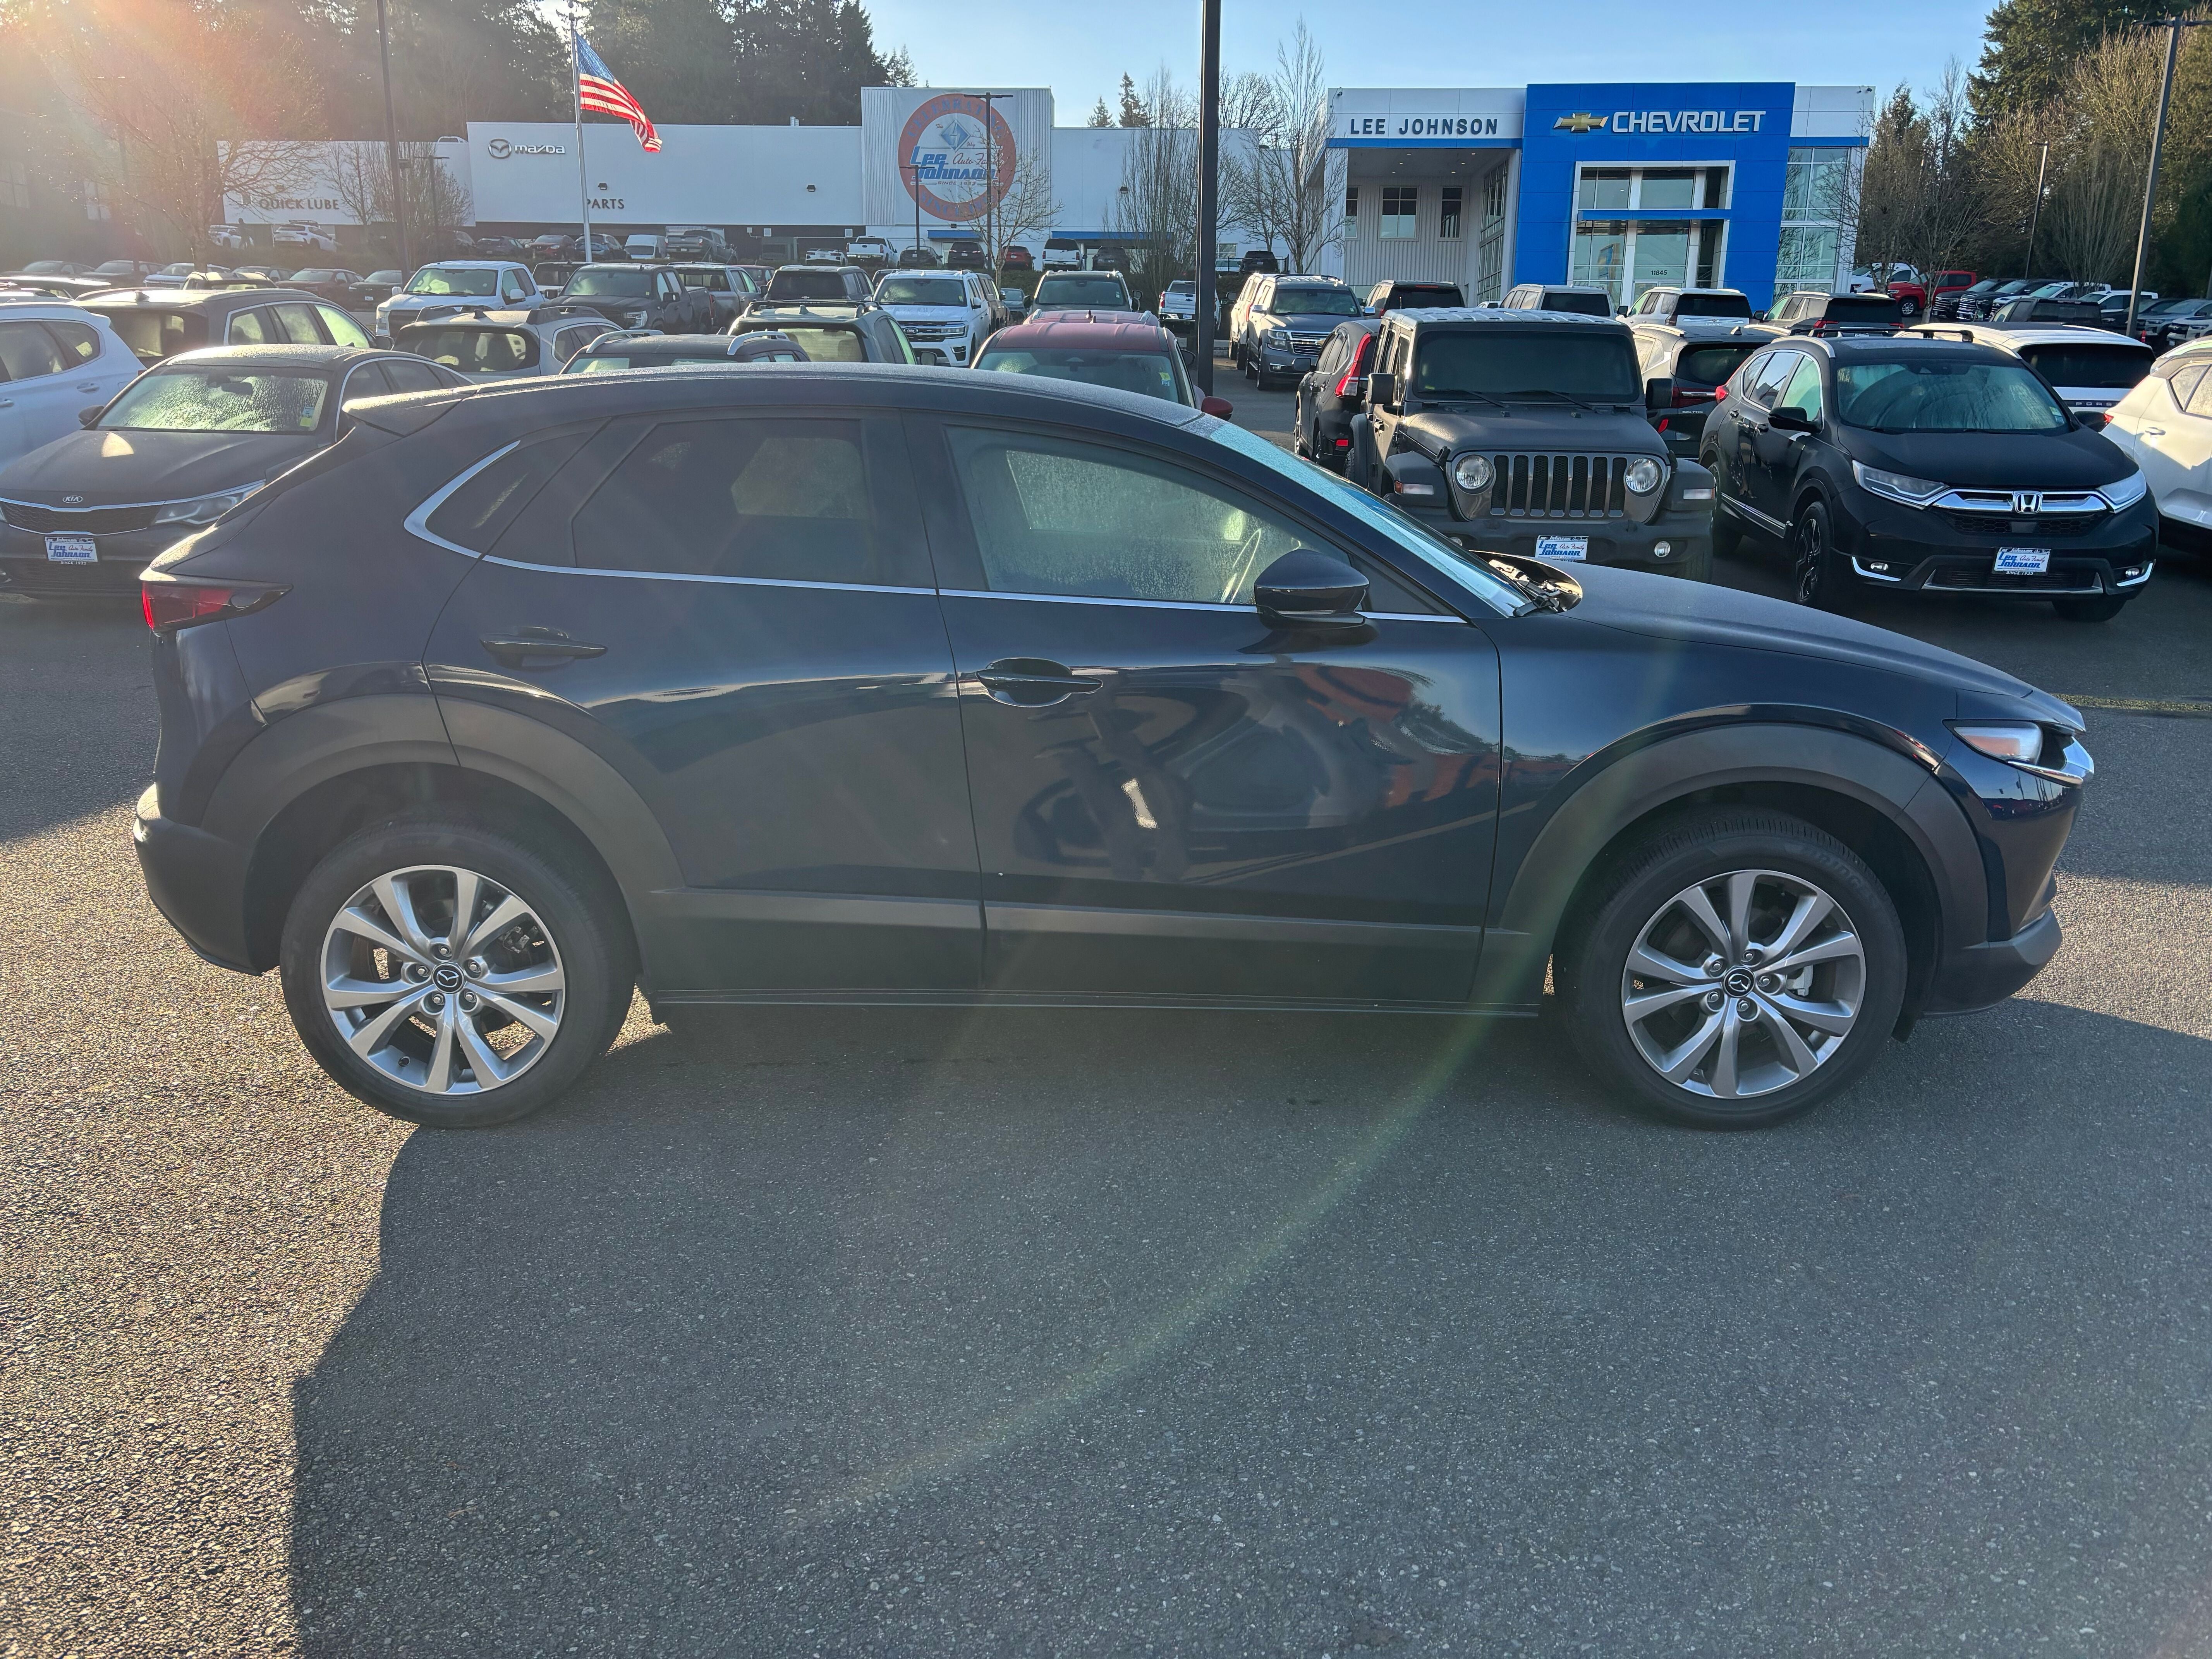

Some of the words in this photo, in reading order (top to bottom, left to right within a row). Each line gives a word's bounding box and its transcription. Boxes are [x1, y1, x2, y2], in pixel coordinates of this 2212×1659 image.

[1350, 118, 1386, 135] LEE
[1399, 118, 1498, 135] JOHNSON
[1612, 111, 1766, 132] CHEVROLET
[910, 146, 948, 165] Lee
[953, 153, 974, 164] Auto
[912, 163, 998, 180] Johnson
[259, 198, 304, 210] QUICK
[307, 199, 340, 210] LUBE
[49, 542, 67, 551] Lee
[1539, 540, 1557, 549] Lee
[51, 549, 92, 558] Johnson
[1998, 551, 2018, 560] Lee
[1997, 560, 2040, 568] Johnson
